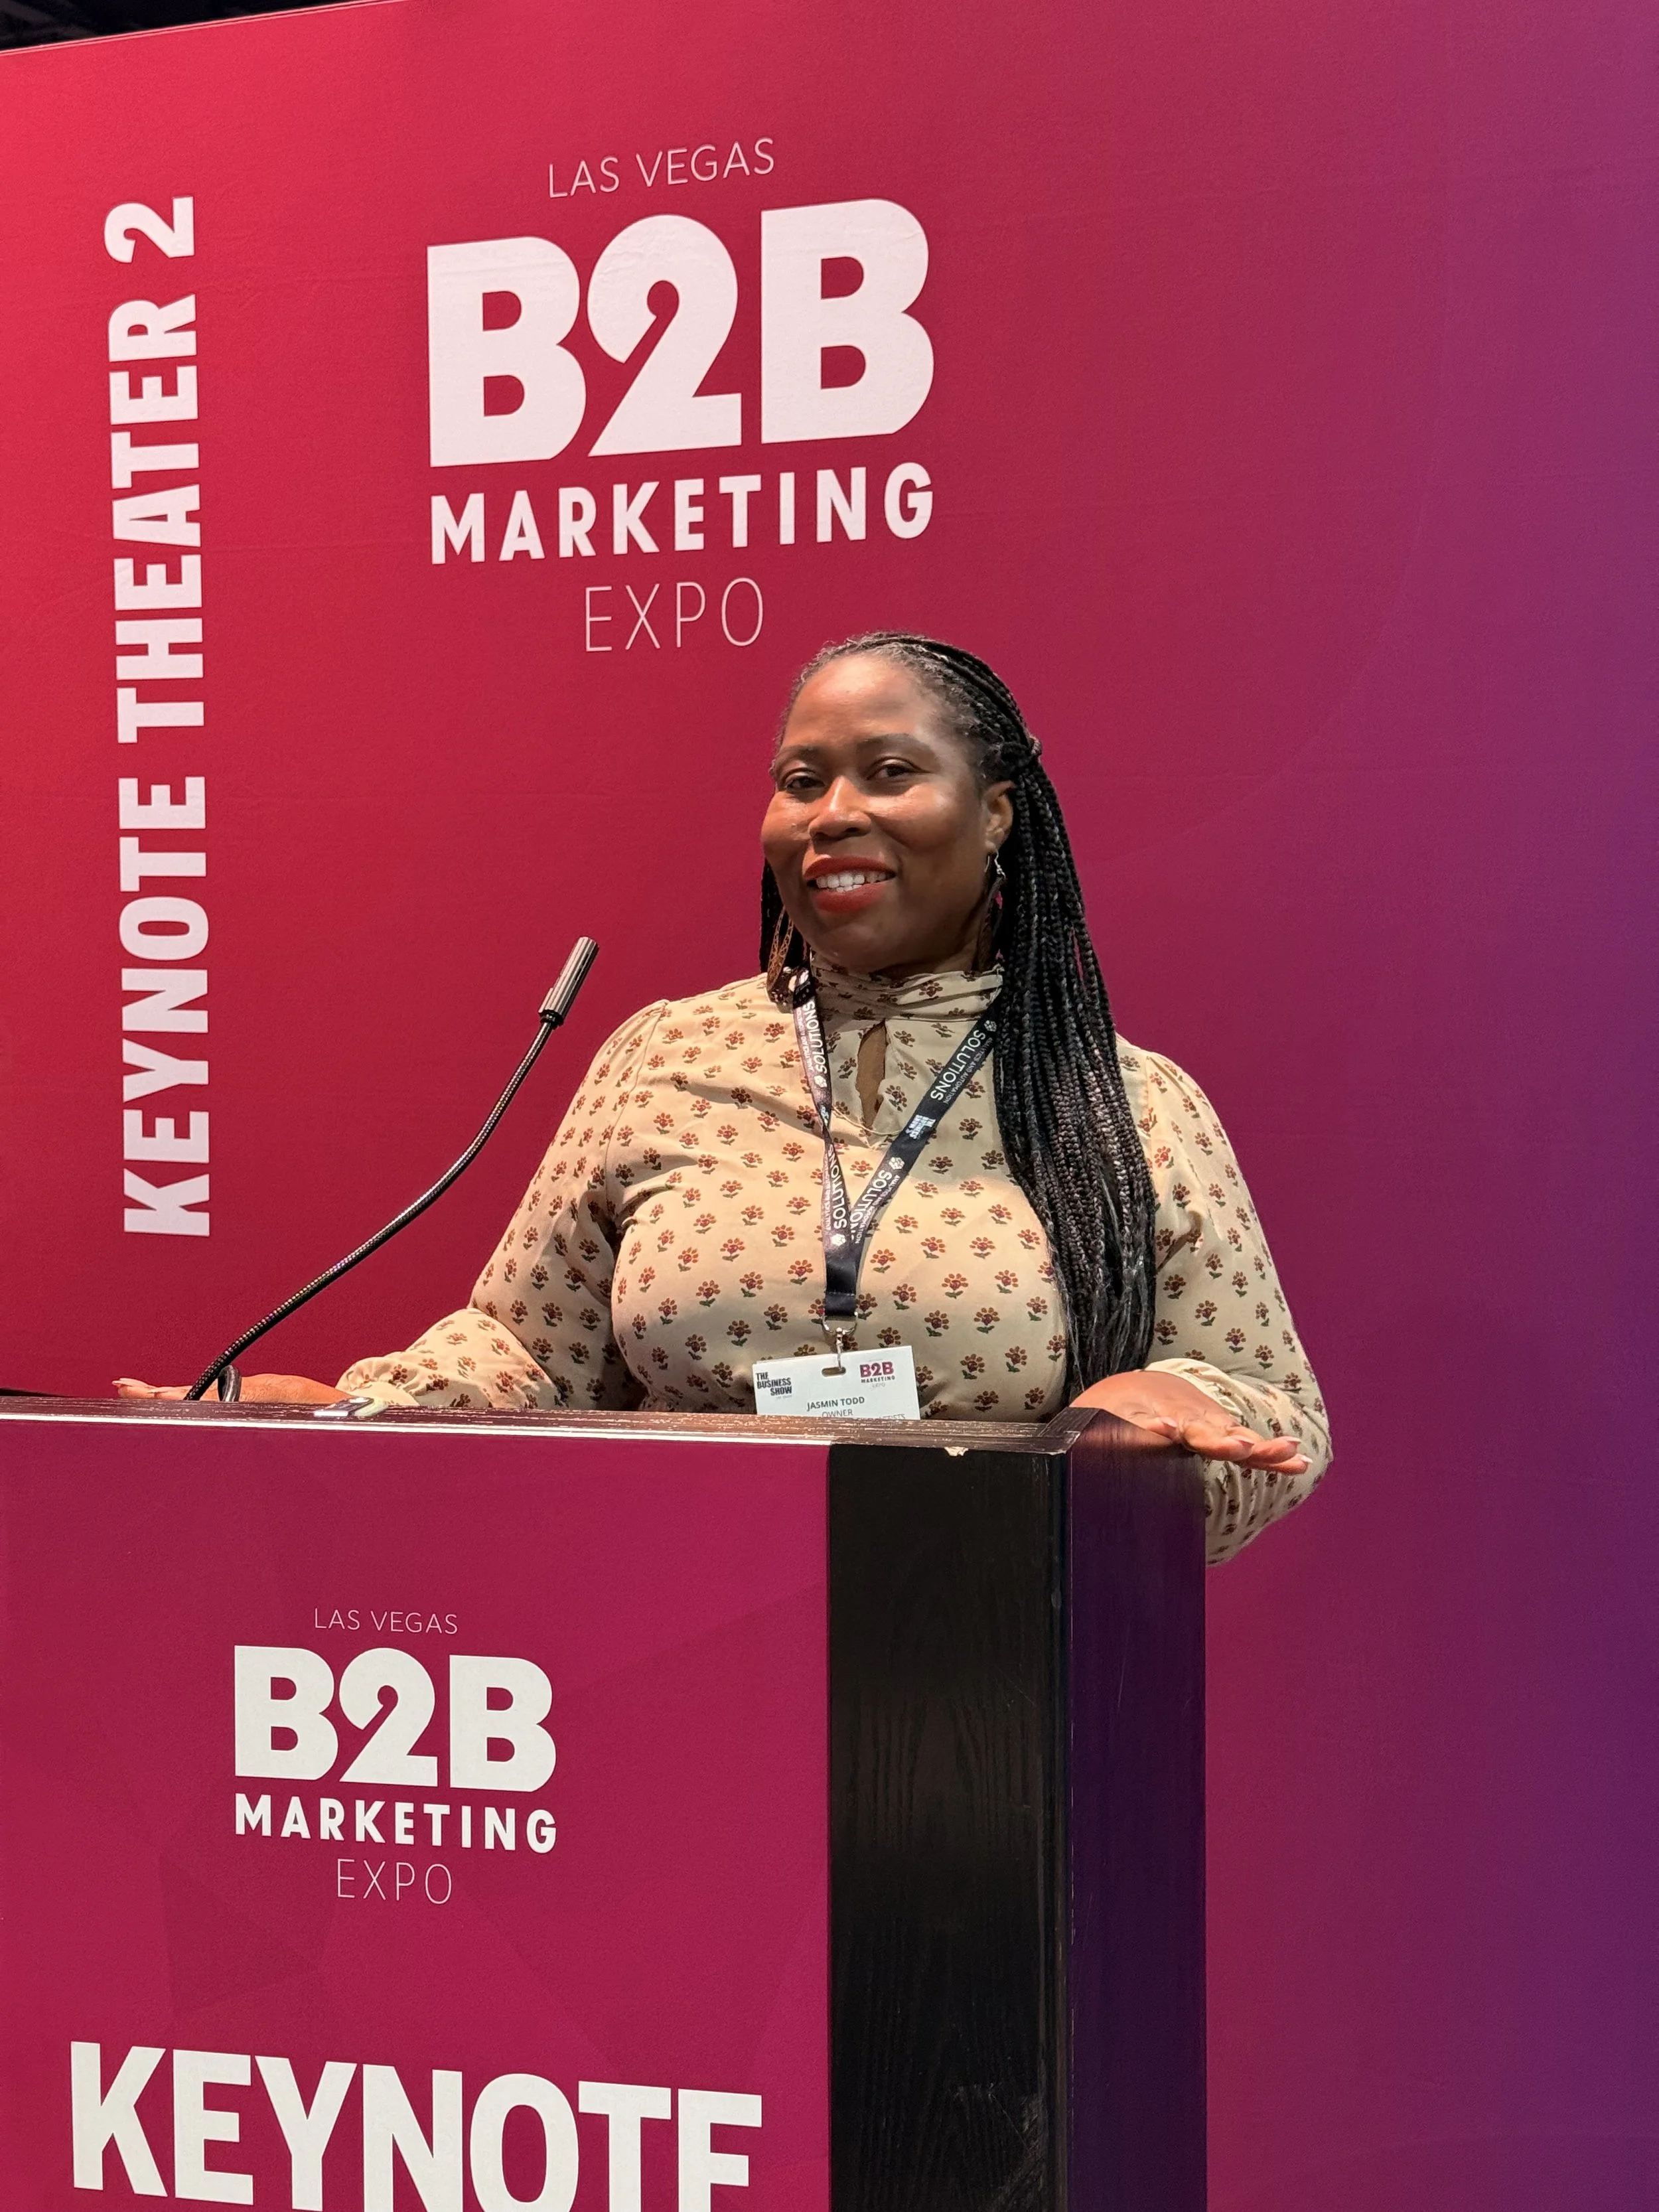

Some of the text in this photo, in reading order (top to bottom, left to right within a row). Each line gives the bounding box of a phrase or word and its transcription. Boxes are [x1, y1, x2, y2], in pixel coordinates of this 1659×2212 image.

[549, 138, 775, 198] LAS VEGAS
[427, 198, 934, 468] B2B
[431, 462, 934, 565] MARKETING
[585, 577, 764, 653] EXPO
[104, 196, 210, 1237] KEYNOTE THEATER 2
[802, 1001, 828, 1075] SOLUTIONS
[930, 1029, 986, 1102] SOLUTIONS
[828, 1144, 847, 1228] SOLUTIONS
[755, 1371, 768, 1380] THE
[757, 1377, 791, 1389] BUSINESS
[770, 1385, 792, 1396] SHOW
[859, 1361, 894, 1377] B2B
[806, 1396, 865, 1412] JASMIN TODD
[822, 1408, 853, 1418] OWNER
[315, 1608, 459, 1635] LAS VEGAS
[234, 1645, 557, 1793] B2B
[235, 1793, 557, 1854] MARKETING
[337, 1859, 453, 1905] EXPO
